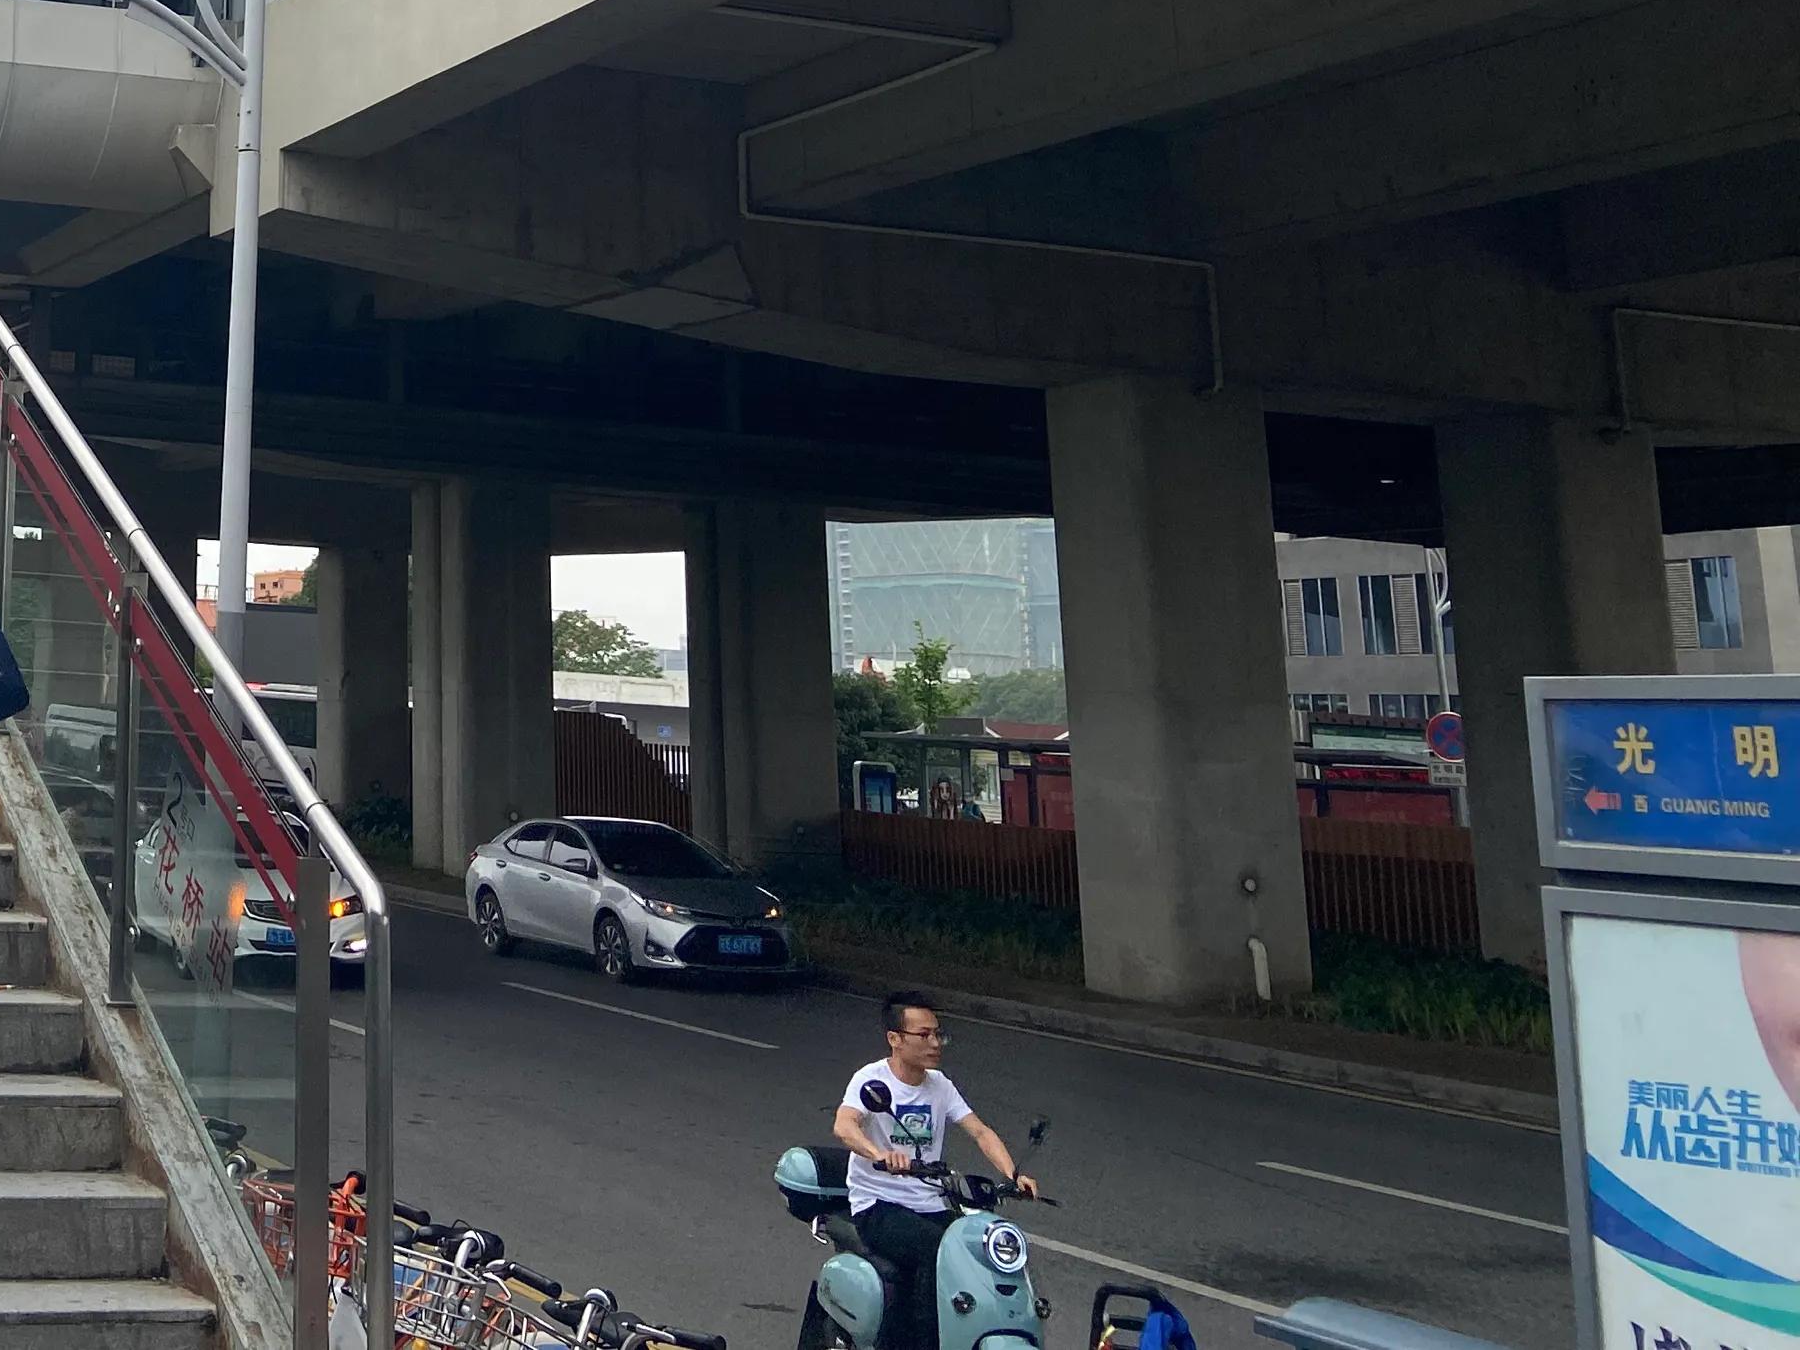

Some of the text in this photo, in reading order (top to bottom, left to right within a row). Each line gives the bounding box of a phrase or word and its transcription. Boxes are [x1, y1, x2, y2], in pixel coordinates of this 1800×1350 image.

[1613, 722, 1780, 778] 光明
[1661, 797, 1771, 819] GUANG MING
[1628, 1080, 1762, 1118] 美丽人生
